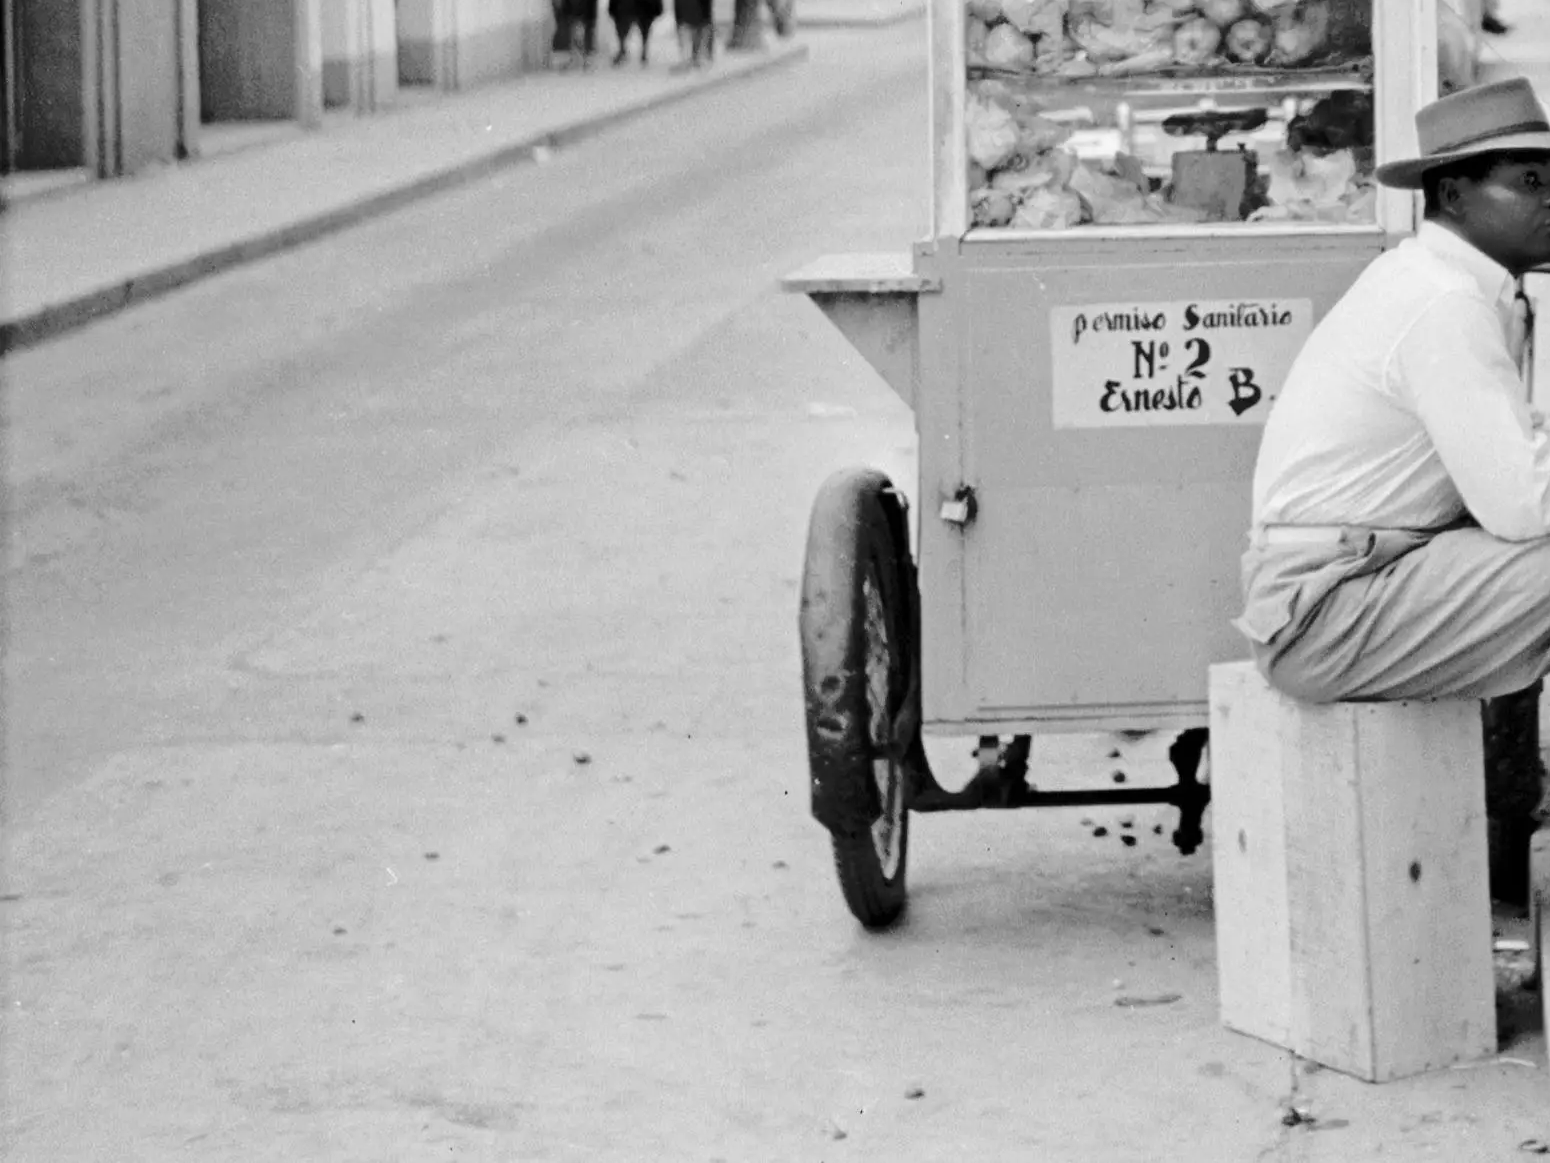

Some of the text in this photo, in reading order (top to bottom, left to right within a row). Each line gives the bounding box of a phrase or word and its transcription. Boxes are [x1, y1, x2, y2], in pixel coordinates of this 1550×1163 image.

[1182, 303, 1293, 331] Sanitario
[1184, 337, 1213, 380] 2
[1099, 374, 1203, 414] Ernesto
